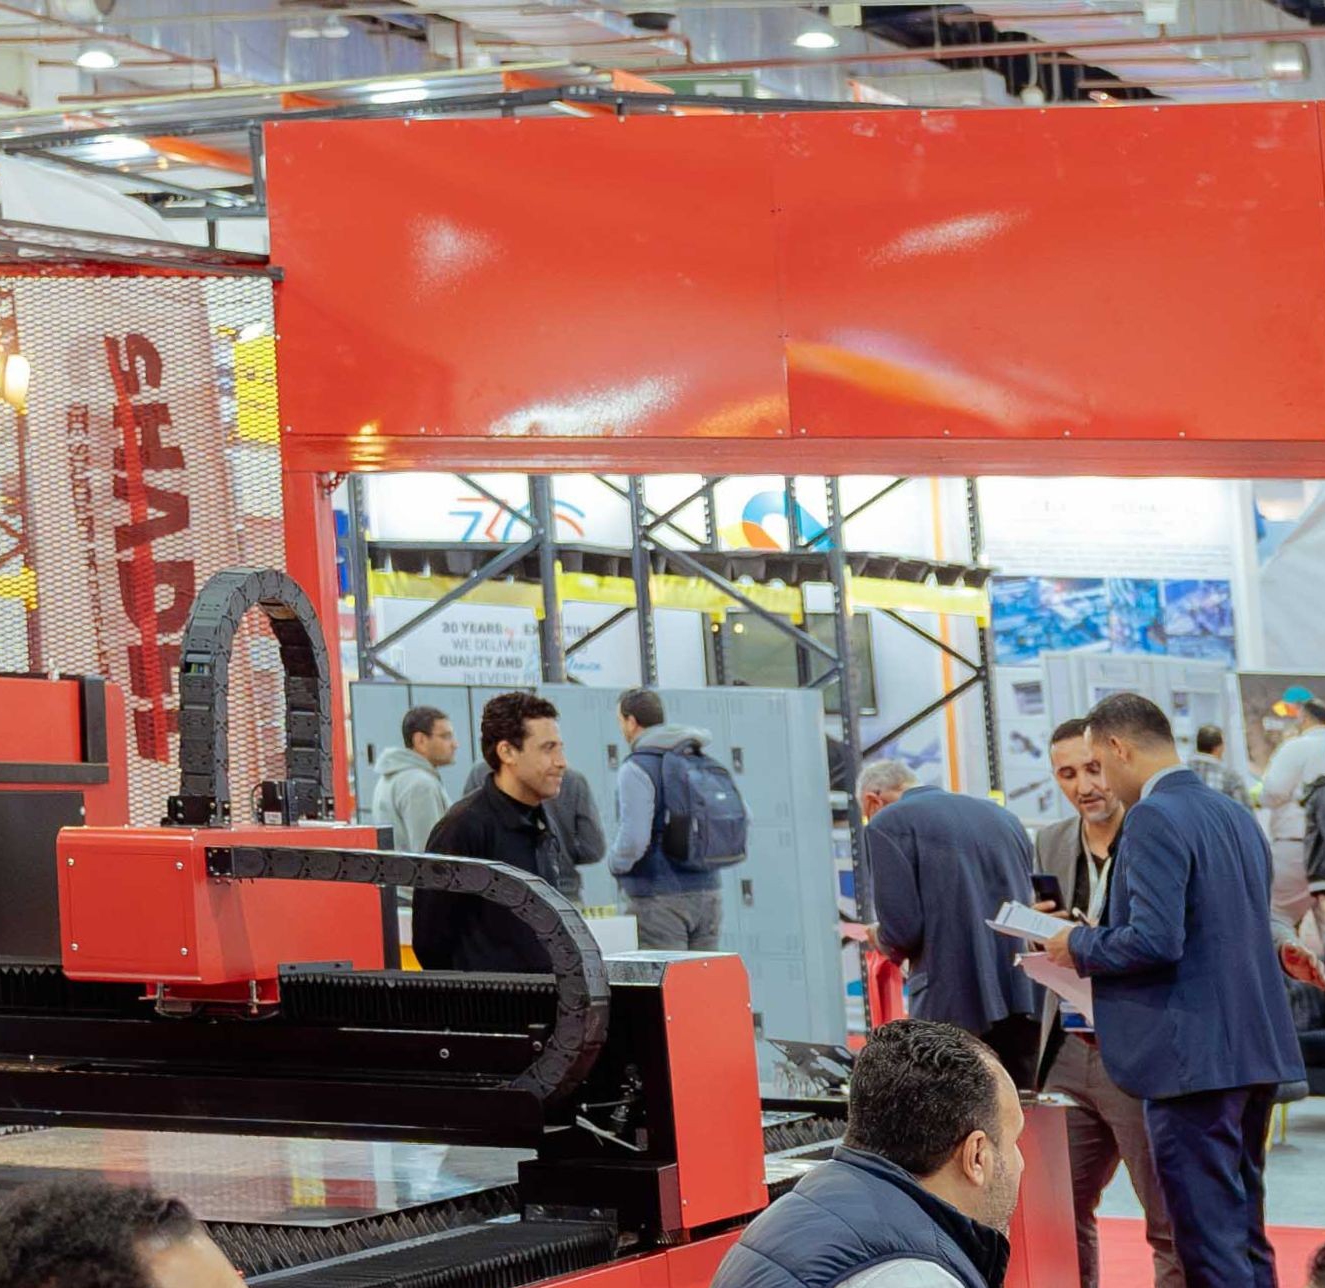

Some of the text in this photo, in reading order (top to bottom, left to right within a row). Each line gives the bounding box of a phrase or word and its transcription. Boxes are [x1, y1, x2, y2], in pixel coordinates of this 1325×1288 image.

[461, 623, 503, 635] YEARS
[439, 655, 492, 668] QUALITY
[496, 656, 523, 669] AND
